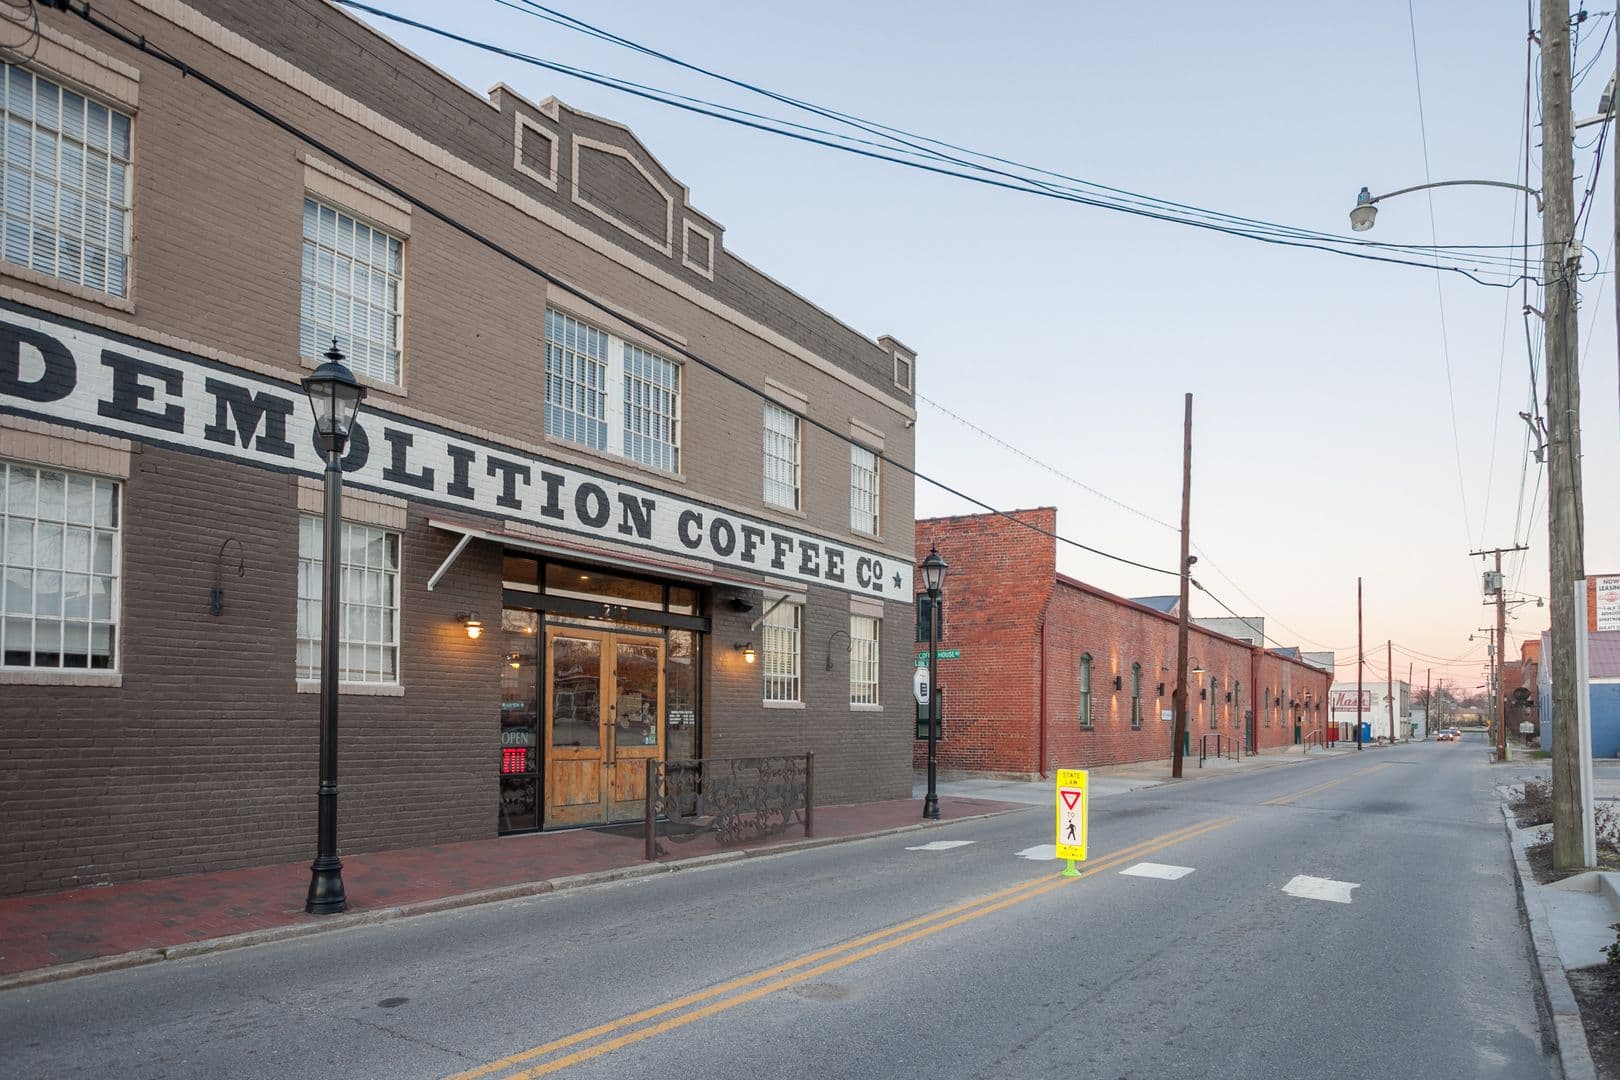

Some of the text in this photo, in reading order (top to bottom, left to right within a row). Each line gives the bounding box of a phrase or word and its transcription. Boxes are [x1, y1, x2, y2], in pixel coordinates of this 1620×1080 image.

[0, 319, 656, 540] DEMOLITION
[678, 509, 845, 583] COFFEE
[501, 732, 529, 745] OPEN
[1062, 771, 1081, 779] STATE
